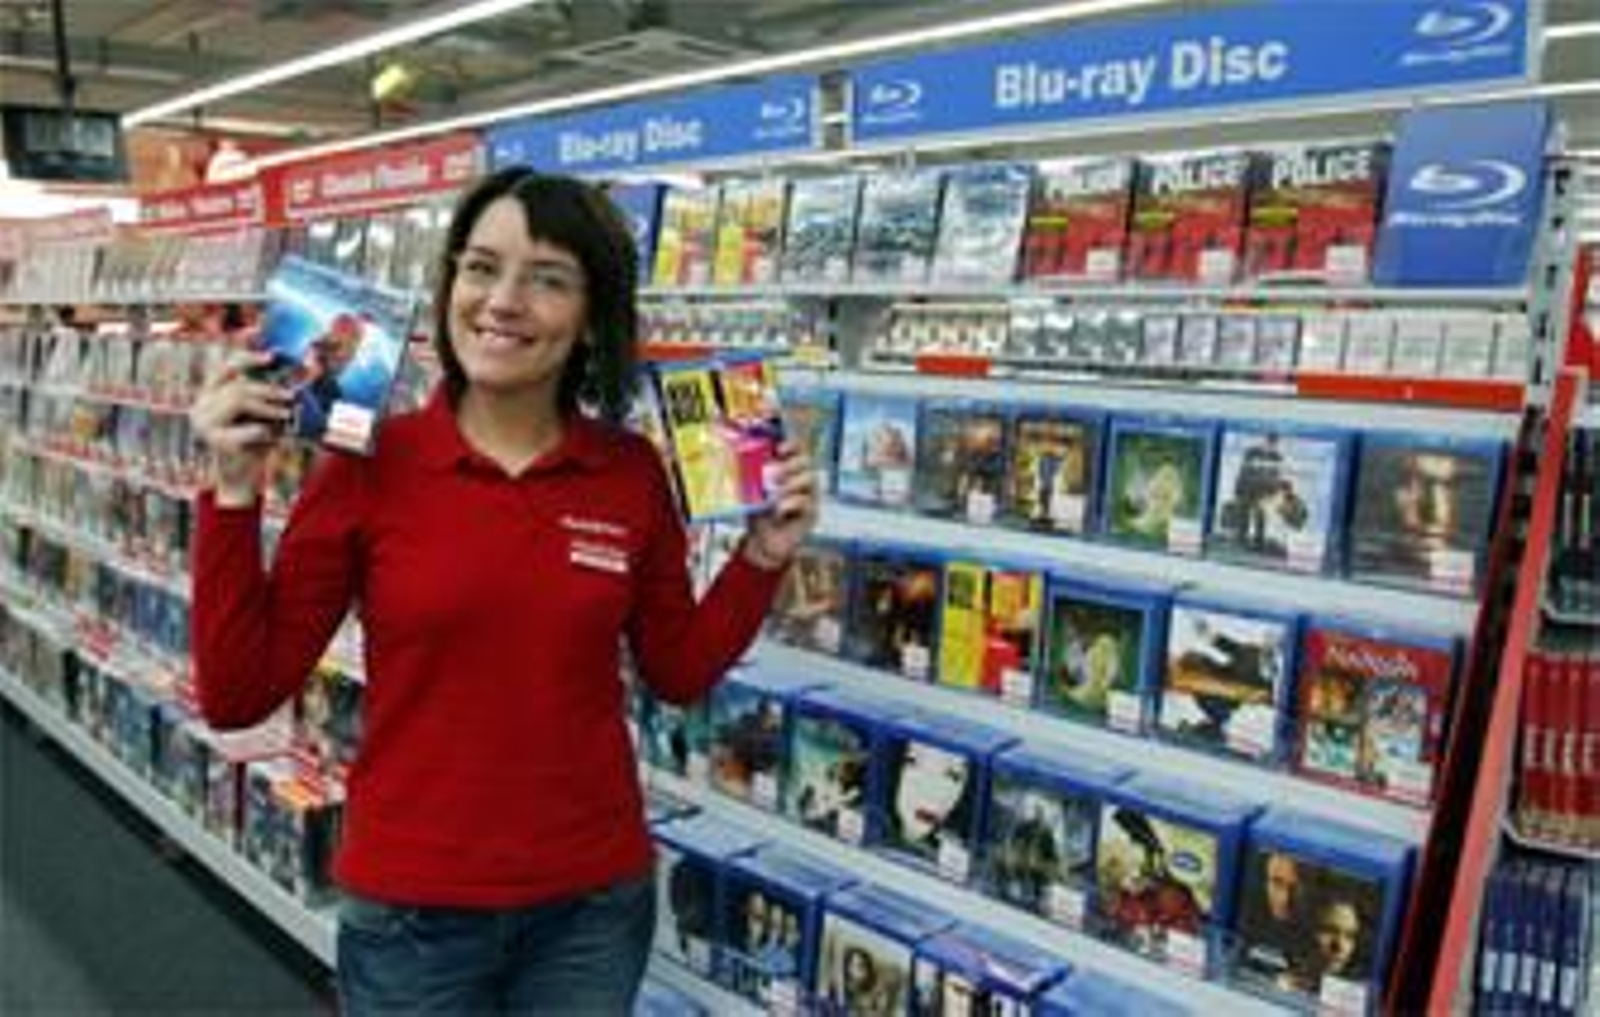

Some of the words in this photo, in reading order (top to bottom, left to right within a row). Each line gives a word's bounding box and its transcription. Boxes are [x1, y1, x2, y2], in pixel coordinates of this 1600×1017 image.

[995, 61, 1156, 106] Blu-ray
[1171, 36, 1288, 88] Disc
[645, 113, 702, 152] Disc
[1271, 148, 1371, 188] POLICE
